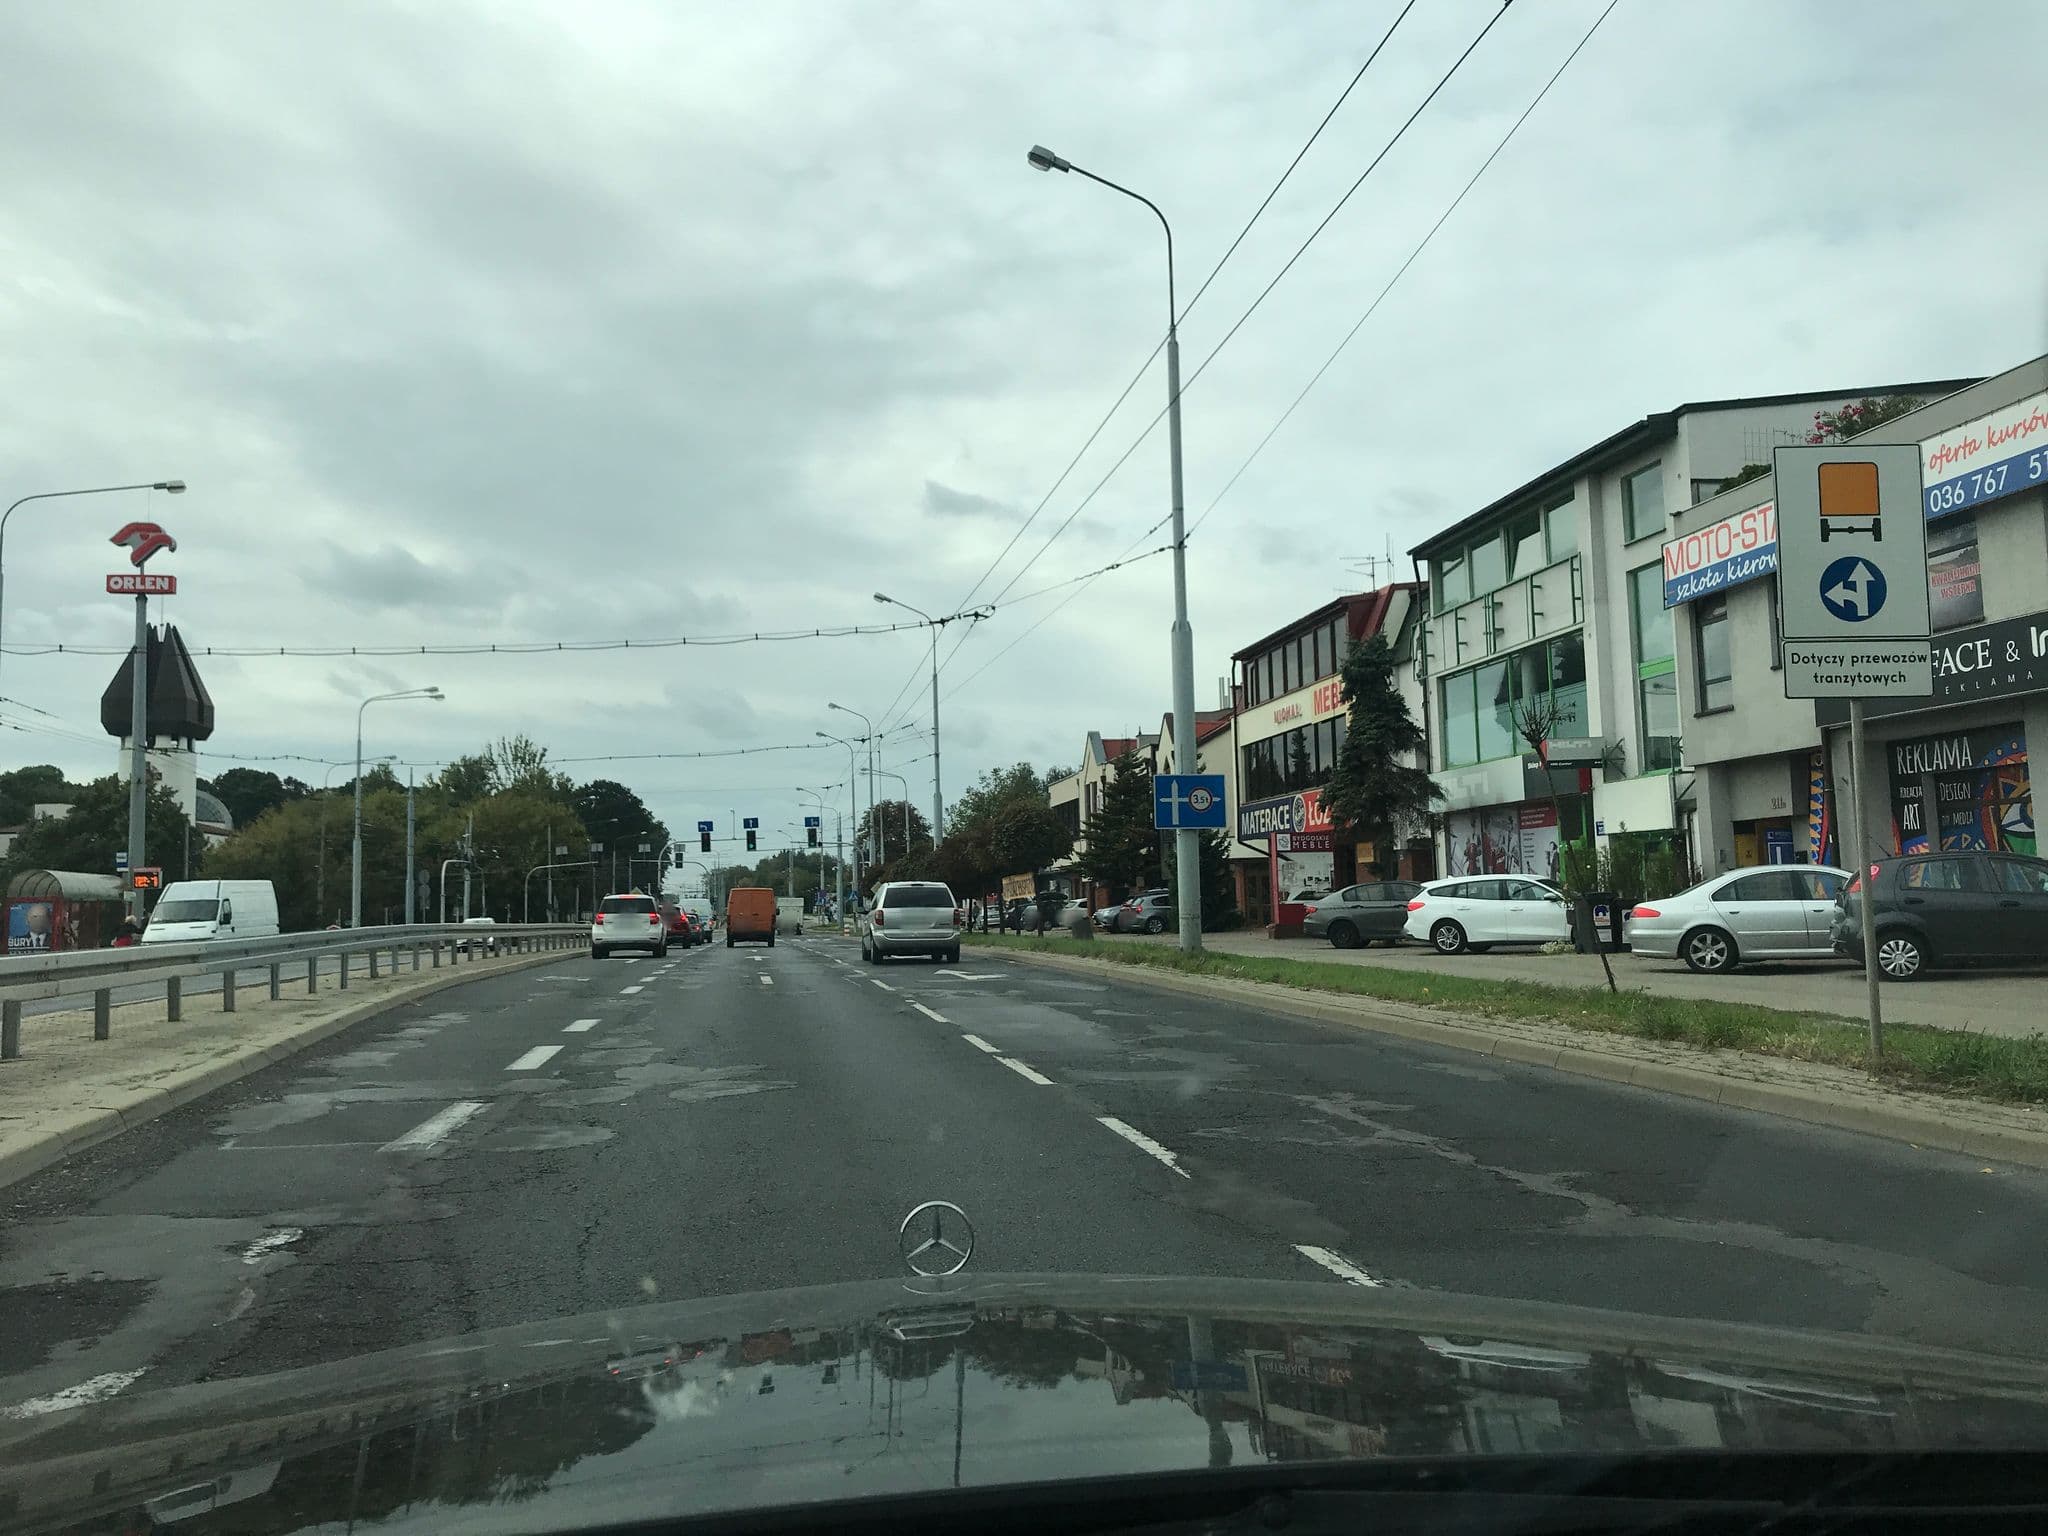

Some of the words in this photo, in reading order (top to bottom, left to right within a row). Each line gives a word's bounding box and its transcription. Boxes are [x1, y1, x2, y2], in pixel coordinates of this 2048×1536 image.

[1929, 436, 1982, 474] oferta
[1930, 480, 1965, 512] 036
[1971, 465, 2008, 499] 767
[109, 576, 169, 590] ORLEN
[1791, 652, 1845, 667] Dotyczy
[1851, 651, 1928, 667] przewozów
[2006, 640, 2021, 662] &
[1813, 671, 1907, 687] tranzytowych
[1944, 670, 2034, 695] EKLAMA
[1896, 736, 1973, 775] REKLAMA
[1939, 781, 1971, 801] DESIGN
[1241, 804, 1290, 835] MATERACE
[1903, 803, 1920, 830] ART
[1292, 841, 1330, 849] MEBLE
[8, 937, 32, 948] BURY
